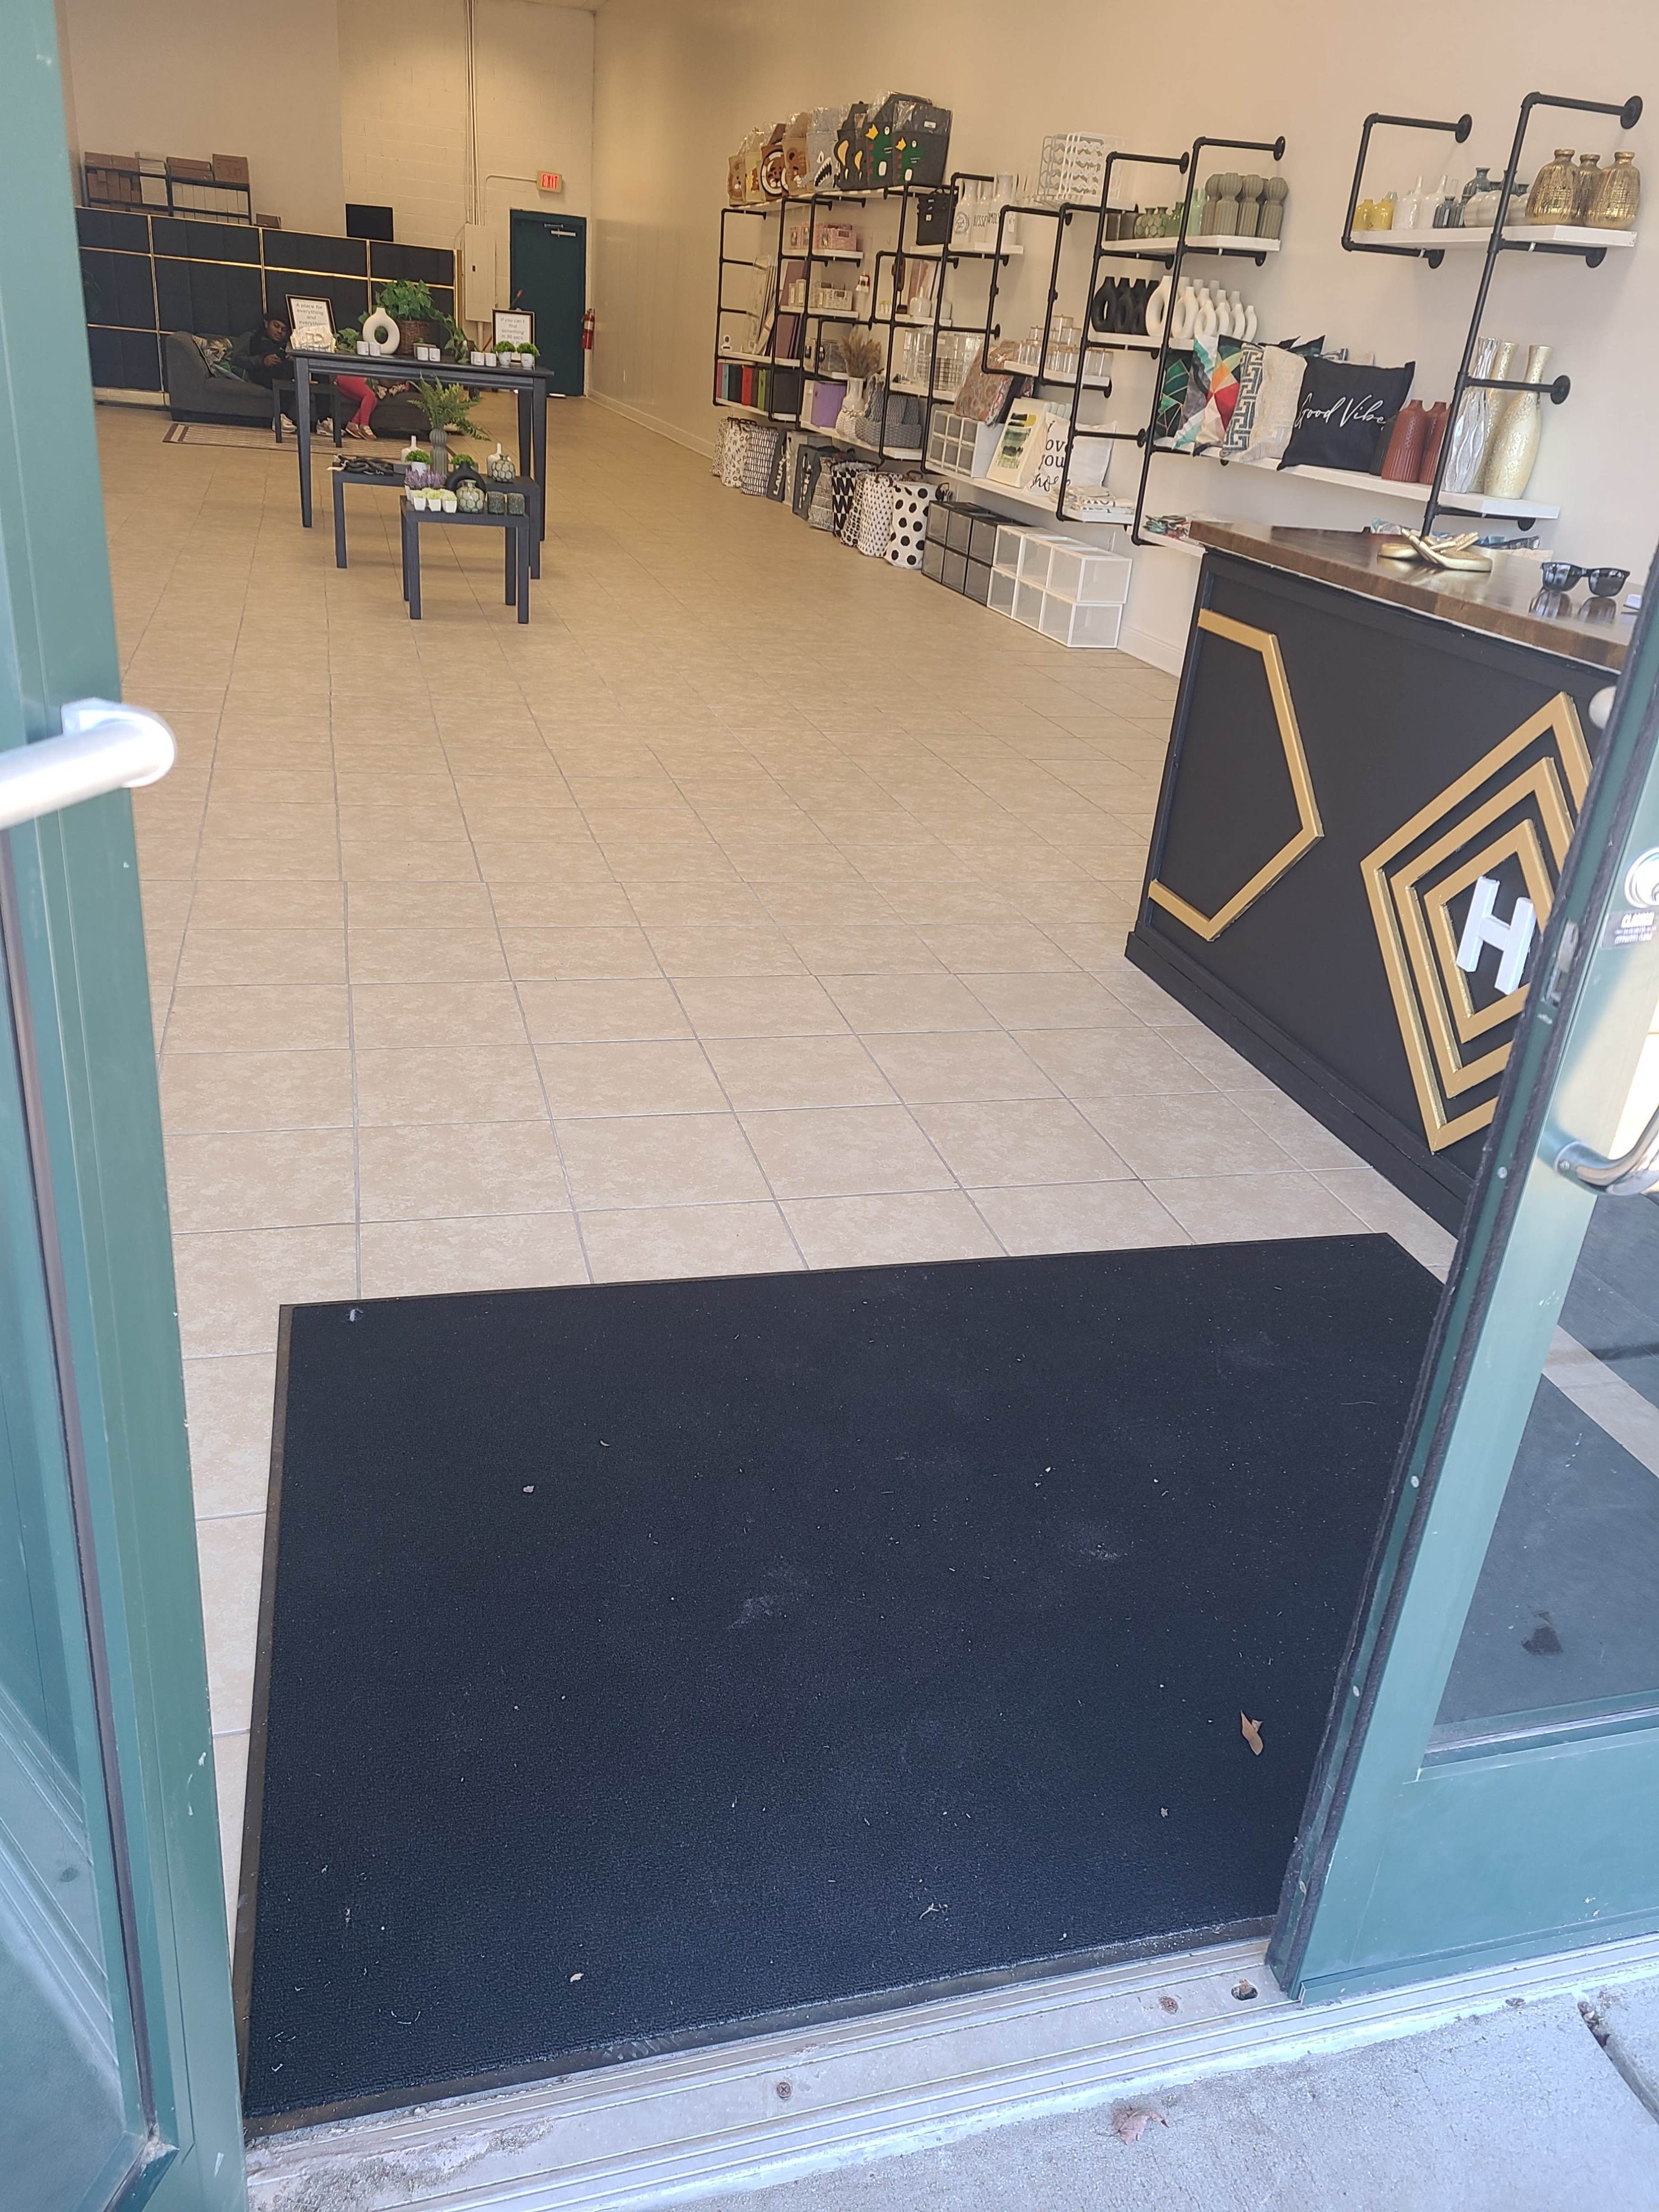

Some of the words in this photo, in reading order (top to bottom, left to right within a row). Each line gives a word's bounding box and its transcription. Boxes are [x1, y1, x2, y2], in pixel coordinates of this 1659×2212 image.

[541, 173, 558, 190] EXIT
[1294, 393, 1346, 429] Good
[1456, 876, 1536, 995] H
